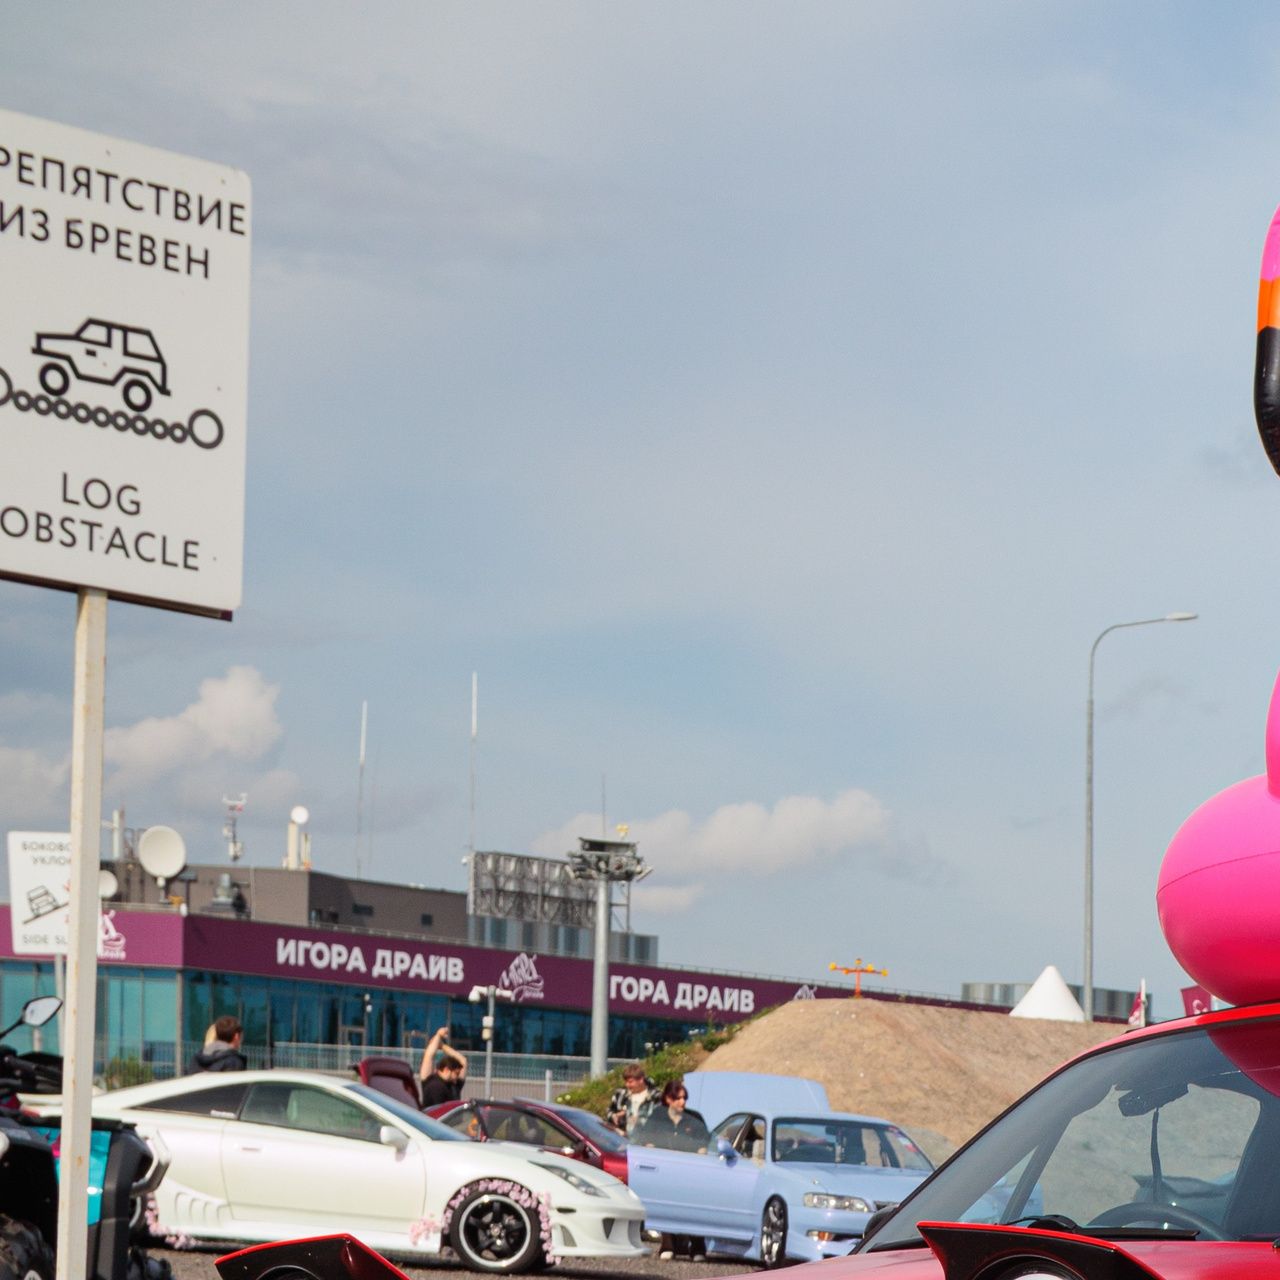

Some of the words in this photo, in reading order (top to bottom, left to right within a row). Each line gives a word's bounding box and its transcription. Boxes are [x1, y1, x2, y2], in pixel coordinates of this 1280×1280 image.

[0, 200, 49, 241] ИЗ
[65, 218, 211, 279] БРЕВЕН
[62, 472, 141, 516] LOG
[0, 507, 200, 571] OBSTACLE
[33, 856, 71, 865] УКЛО
[23, 935, 49, 944] SIDE
[276, 937, 367, 973] ИГОРА
[372, 948, 465, 983] ДРАЙВ
[609, 975, 670, 1005] ГОРА
[674, 982, 755, 1013] ДРАЙВ
